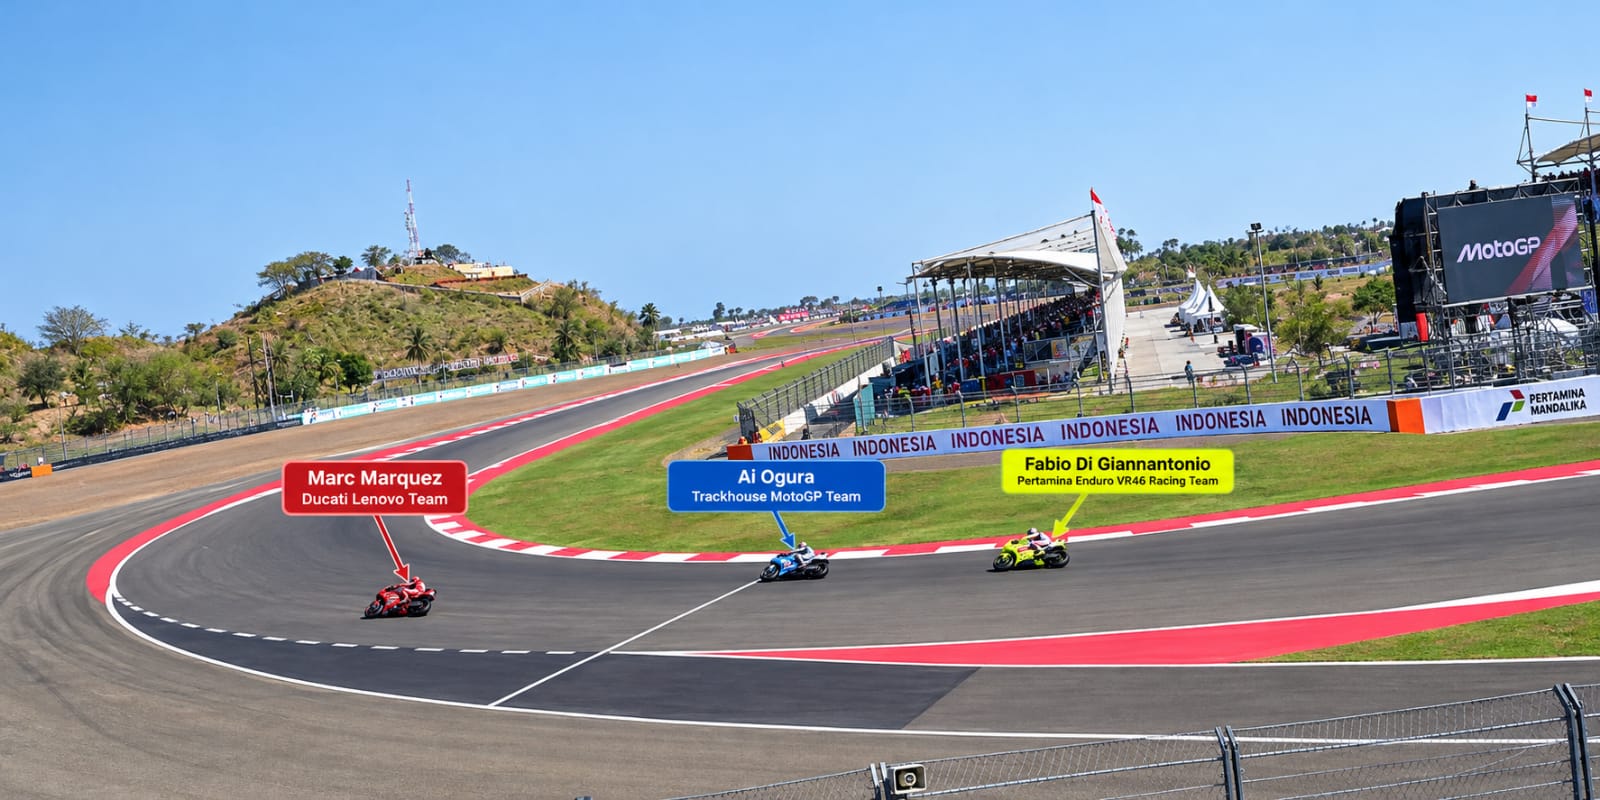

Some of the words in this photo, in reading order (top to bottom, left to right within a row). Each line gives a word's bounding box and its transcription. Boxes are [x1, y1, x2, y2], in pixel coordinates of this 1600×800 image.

[1457, 236, 1541, 262] MotoGP
[1529, 388, 1585, 404] PERTAMINA
[1530, 401, 1586, 415] MANDALIKA
[769, 443, 840, 460] INDONESIA
[854, 436, 936, 456] INDONESIA
[951, 426, 1043, 447] INDONESIA
[1061, 416, 1160, 439] INDONESIA
[1175, 409, 1267, 432] INDONESIA
[1281, 405, 1373, 427] INDONESIA
